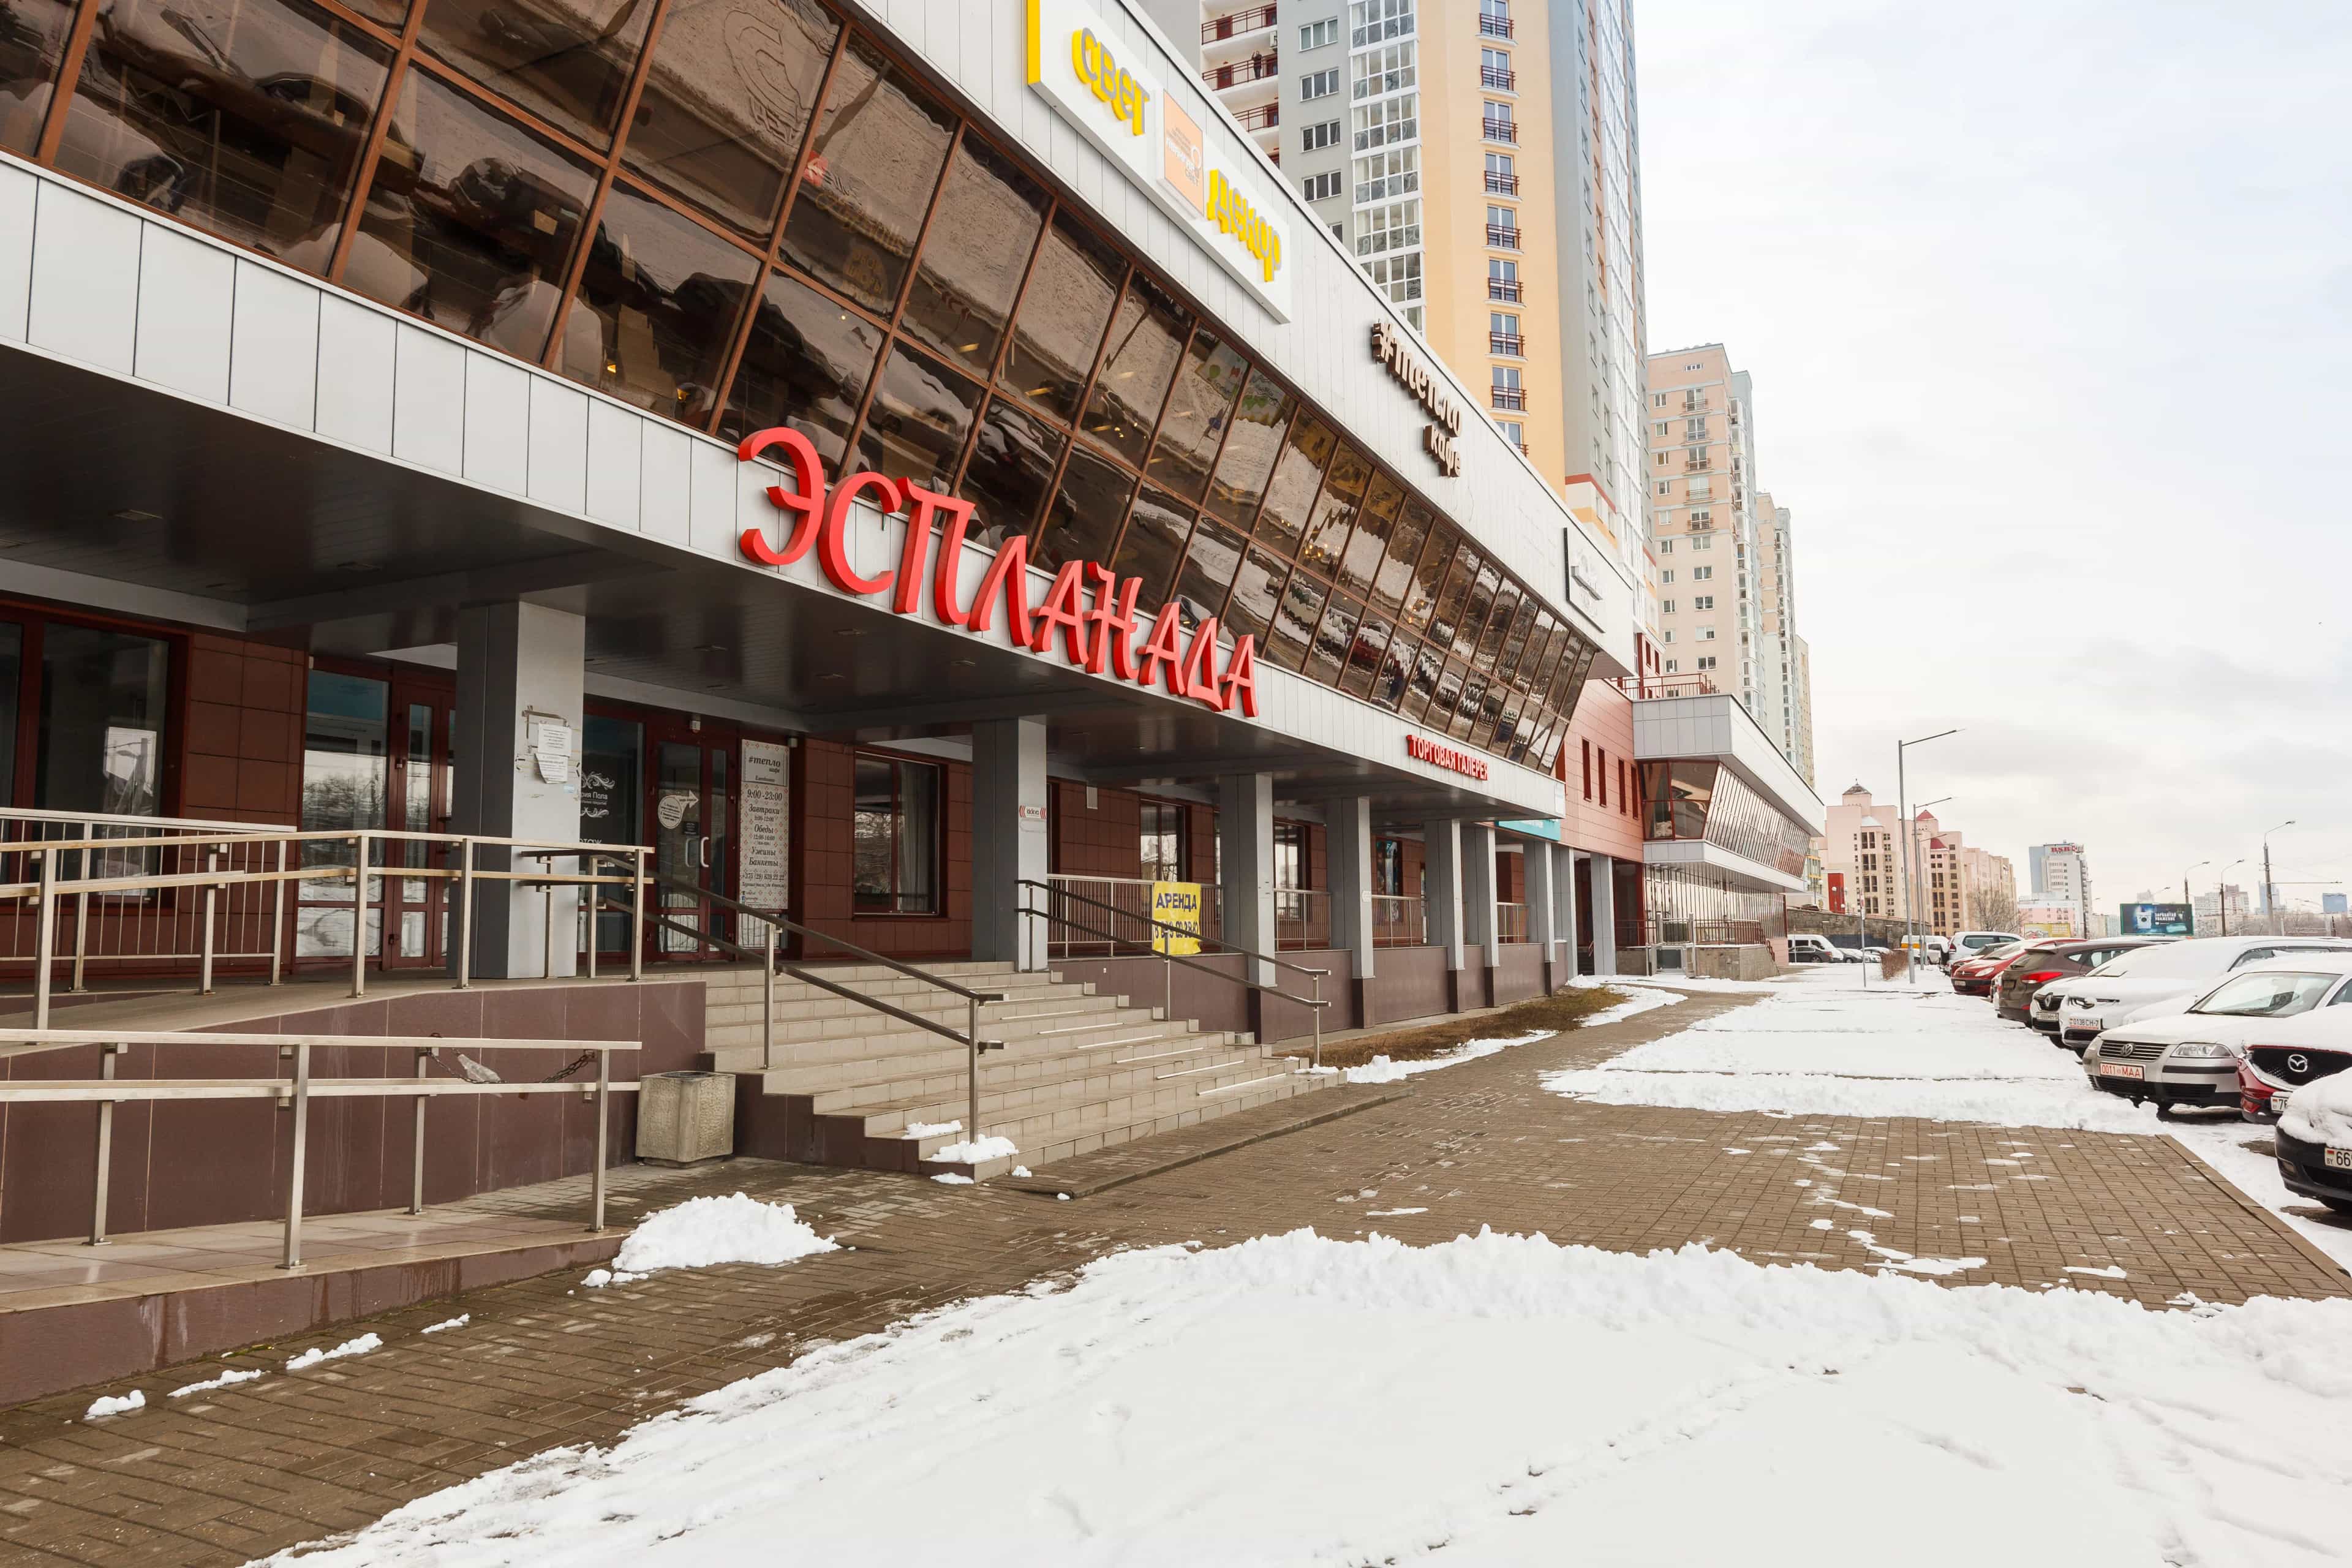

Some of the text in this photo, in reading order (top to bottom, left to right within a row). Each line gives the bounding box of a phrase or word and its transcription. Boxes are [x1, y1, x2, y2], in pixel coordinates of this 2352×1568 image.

[1423, 424, 1461, 477] кафе
[738, 427, 1259, 718] ЭСПЛАНАДА
[1406, 734, 1489, 780] ТОРГОВАЯ ГАЛЕРЕЯ
[748, 803, 780, 815] Завтраки
[754, 824, 774, 834] Обеды
[752, 846, 776, 856] Ужины
[748, 857, 778, 867] Банкеты
[1156, 892, 1197, 913] АРЕНДА
[2122, 1066, 2141, 1077] MAA
[2336, 1151, 2352, 1167] 66
